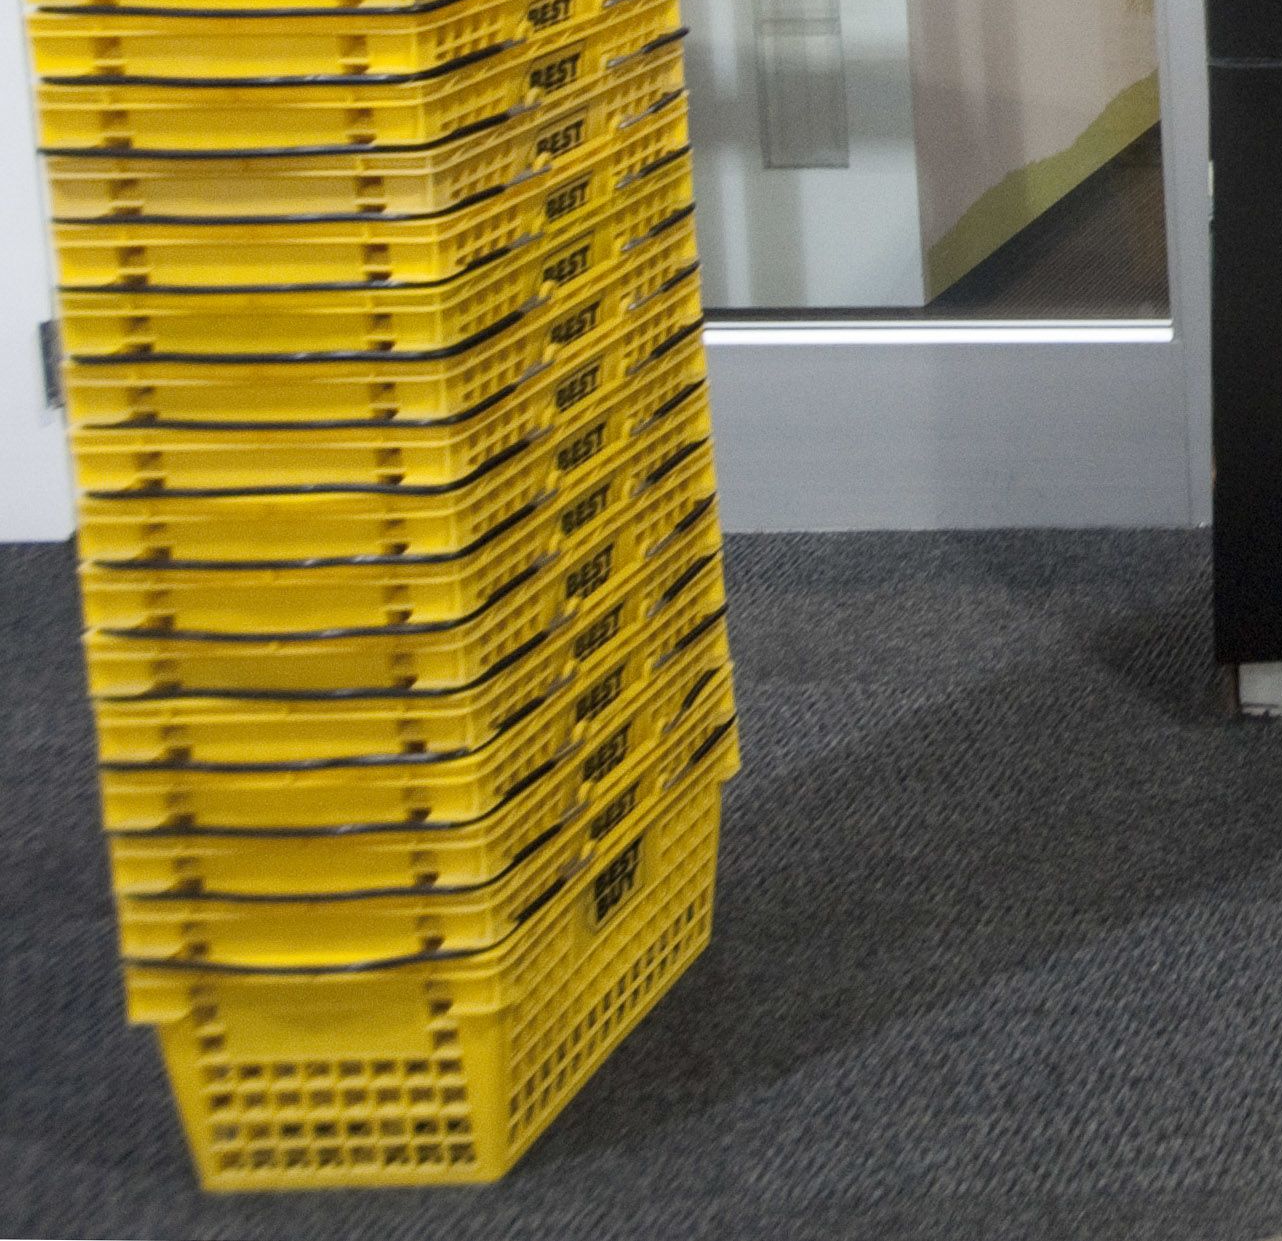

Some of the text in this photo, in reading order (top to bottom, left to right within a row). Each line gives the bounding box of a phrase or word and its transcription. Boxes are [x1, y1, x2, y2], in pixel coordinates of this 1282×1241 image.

[531, 52, 580, 89] BEST
[537, 120, 585, 155] BEST
[546, 180, 589, 219] BEST
[544, 245, 590, 282] BEST
[551, 302, 600, 341] BEST
[557, 365, 599, 407] BEST
[558, 423, 605, 470] BEST
[562, 485, 608, 533] BEST
[566, 543, 614, 595] BEST
[576, 663, 625, 720] BEST
